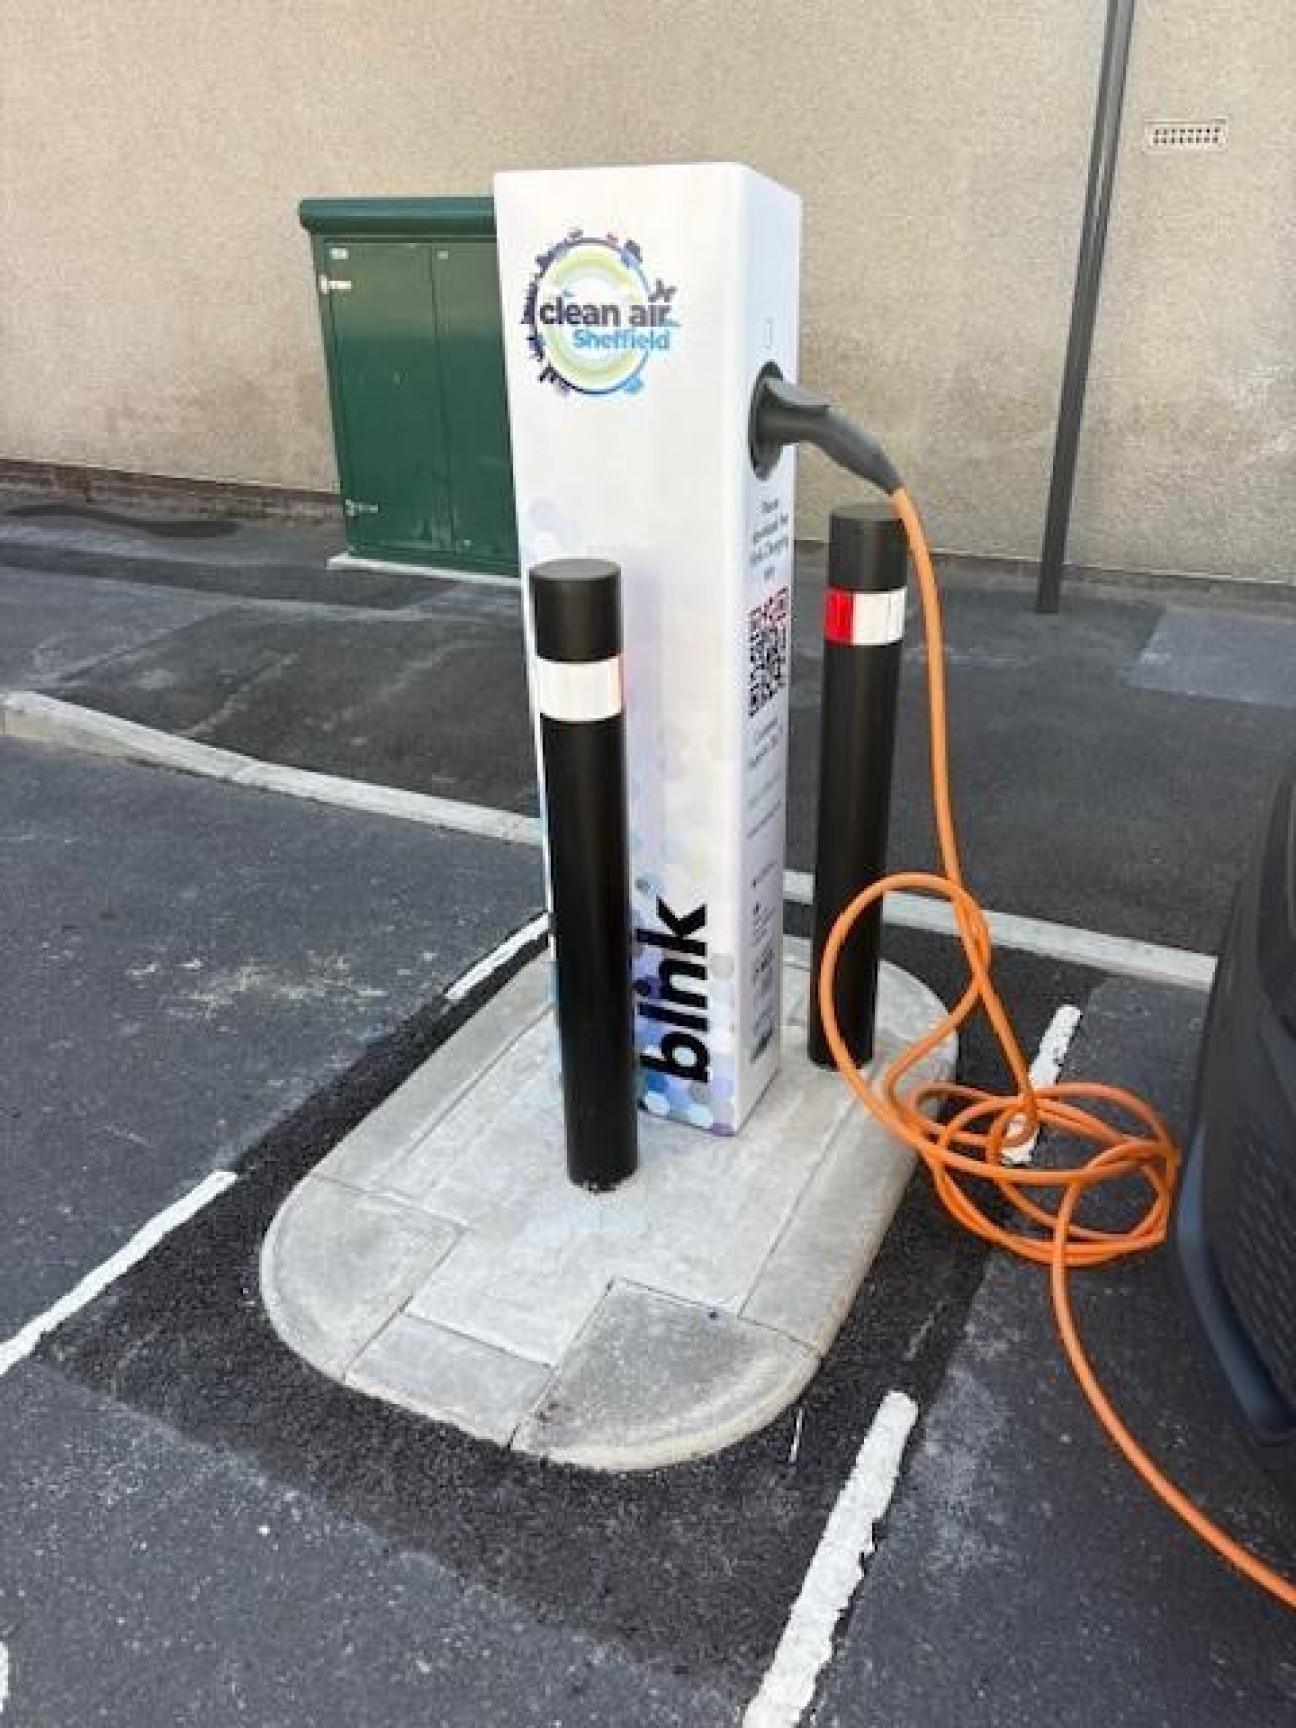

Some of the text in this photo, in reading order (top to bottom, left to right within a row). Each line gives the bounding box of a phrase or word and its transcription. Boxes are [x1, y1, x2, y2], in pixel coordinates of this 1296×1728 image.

[539, 296, 671, 327] clean air
[573, 328, 670, 349] Sheffield
[633, 895, 709, 1083] blink
